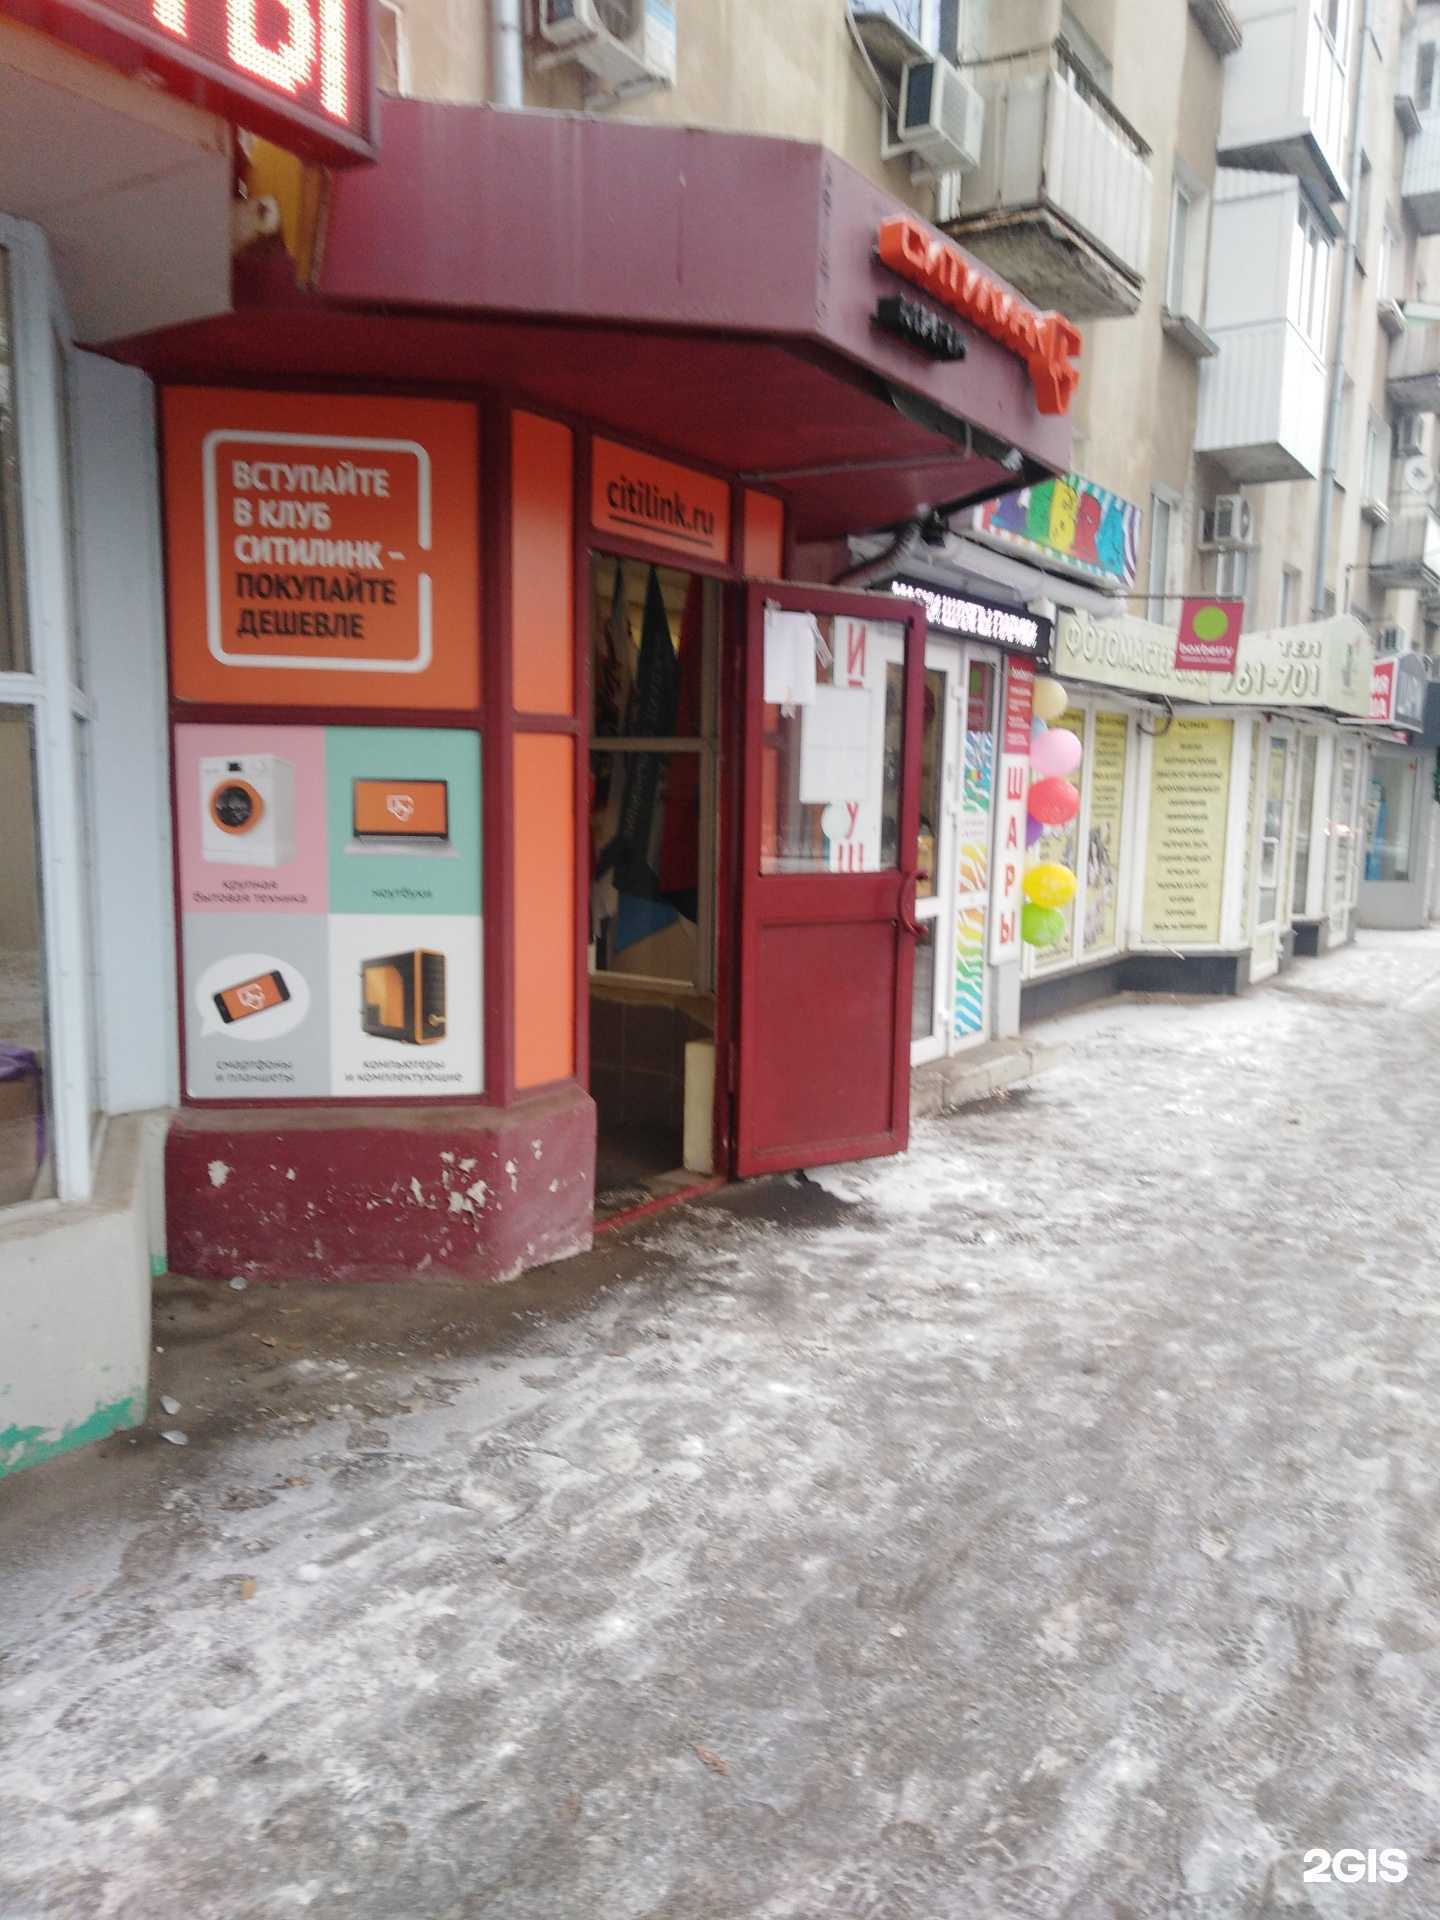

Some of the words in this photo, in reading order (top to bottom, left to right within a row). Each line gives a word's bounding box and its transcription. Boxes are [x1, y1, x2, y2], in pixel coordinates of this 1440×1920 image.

[232, 459, 391, 498] ВСТУПАЙТЕ
[233, 497, 253, 528] В
[258, 499, 332, 531] КЛУБ
[607, 474, 714, 535] citilink.ru
[234, 534, 384, 571] СИТИЛИНК
[235, 570, 397, 605] ПОКУПАЙТЕ
[237, 607, 364, 640] ДЕШЕВЛЕ
[1178, 641, 1236, 658] boxberry
[1000, 766, 1024, 945] ШАРЫ
